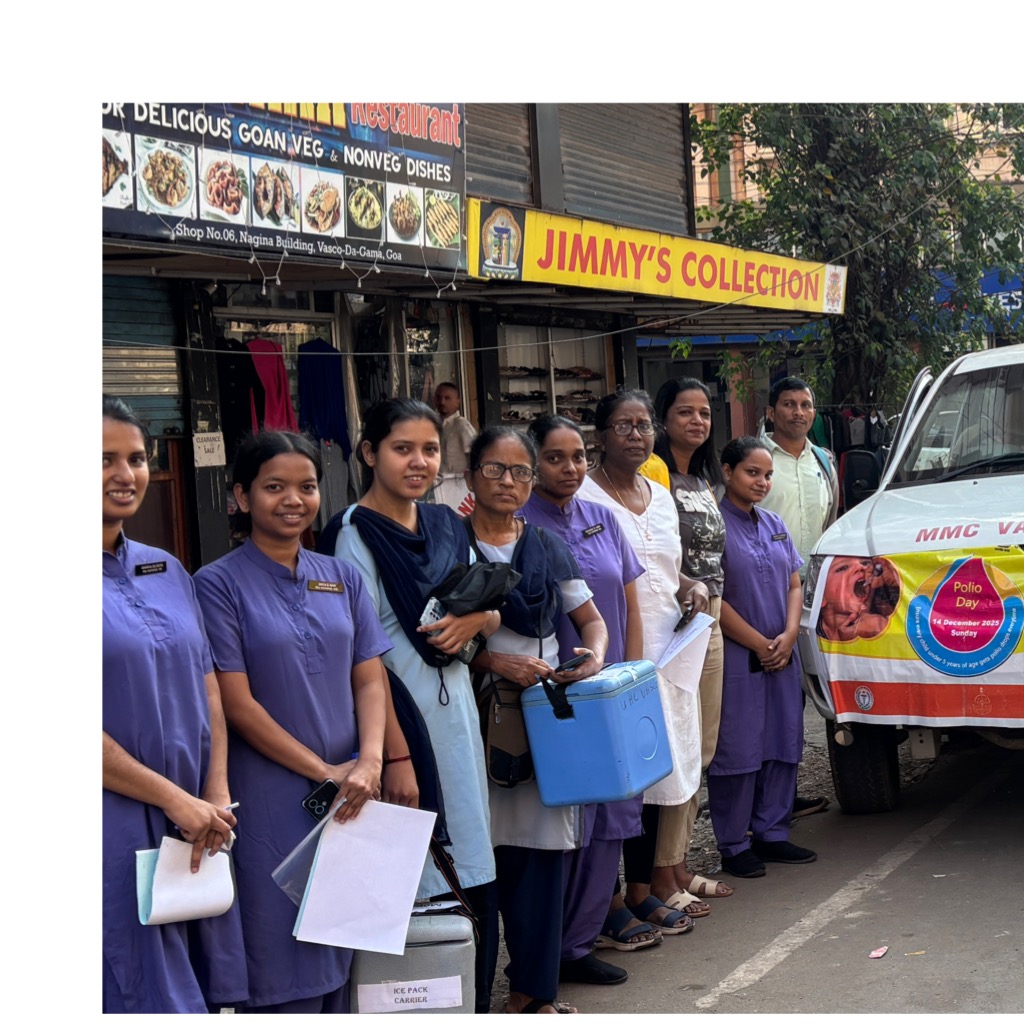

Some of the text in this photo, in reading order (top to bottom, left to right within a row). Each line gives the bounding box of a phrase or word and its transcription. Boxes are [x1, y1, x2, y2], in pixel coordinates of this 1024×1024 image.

[351, 103, 461, 147] Restaurant
[134, 103, 232, 139] DELICIOUS
[238, 123, 286, 150] GOAN
[292, 134, 323, 158] VEG
[330, 150, 338, 162] &
[344, 146, 401, 173] NONVEG
[407, 158, 451, 182] DISHES
[176, 223, 204, 239] Shop
[206, 227, 238, 243] No.06,
[240, 232, 273, 249] Nagina
[276, 237, 316, 254] Building,
[386, 250, 402, 261] Goa
[537, 229, 820, 302] JIMMY'S COLLECTION
[915, 523, 981, 543] MMC
[954, 581, 982, 593] Polio
[956, 597, 980, 610] Day
[981, 619, 999, 627] 2025
[951, 629, 978, 638] Sunday
[919, 638, 930, 652] child
[927, 650, 942, 663] under
[968, 661, 979, 669] age
[979, 656, 991, 666] gets
[990, 647, 1002, 660] polio
[407, 986, 428, 994] PACK
[394, 996, 428, 1004] CARRIER
